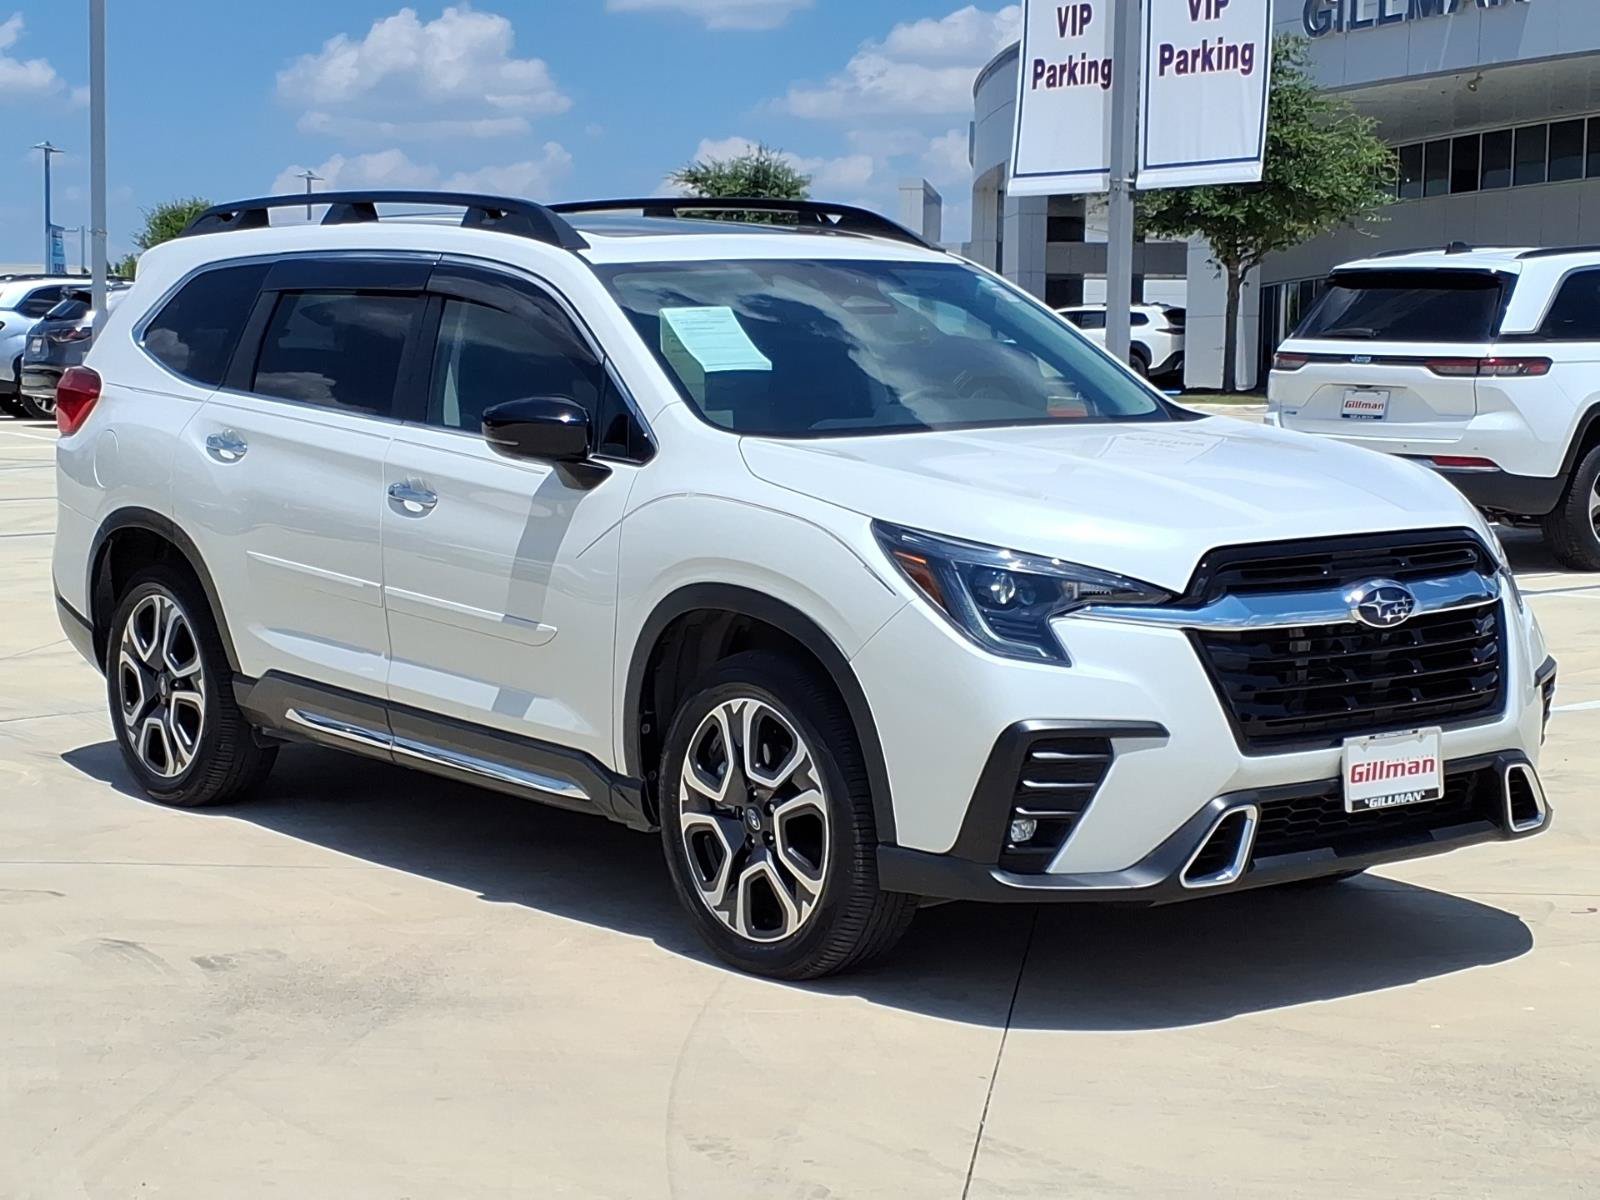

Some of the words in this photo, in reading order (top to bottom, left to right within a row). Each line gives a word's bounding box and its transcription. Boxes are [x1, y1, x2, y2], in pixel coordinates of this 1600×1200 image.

[1056, 3, 1093, 38] VIP
[1031, 52, 1113, 90] Parking
[1158, 37, 1255, 77] Parking
[1344, 400, 1385, 411] Gillman
[1350, 758, 1435, 784] Gillman
